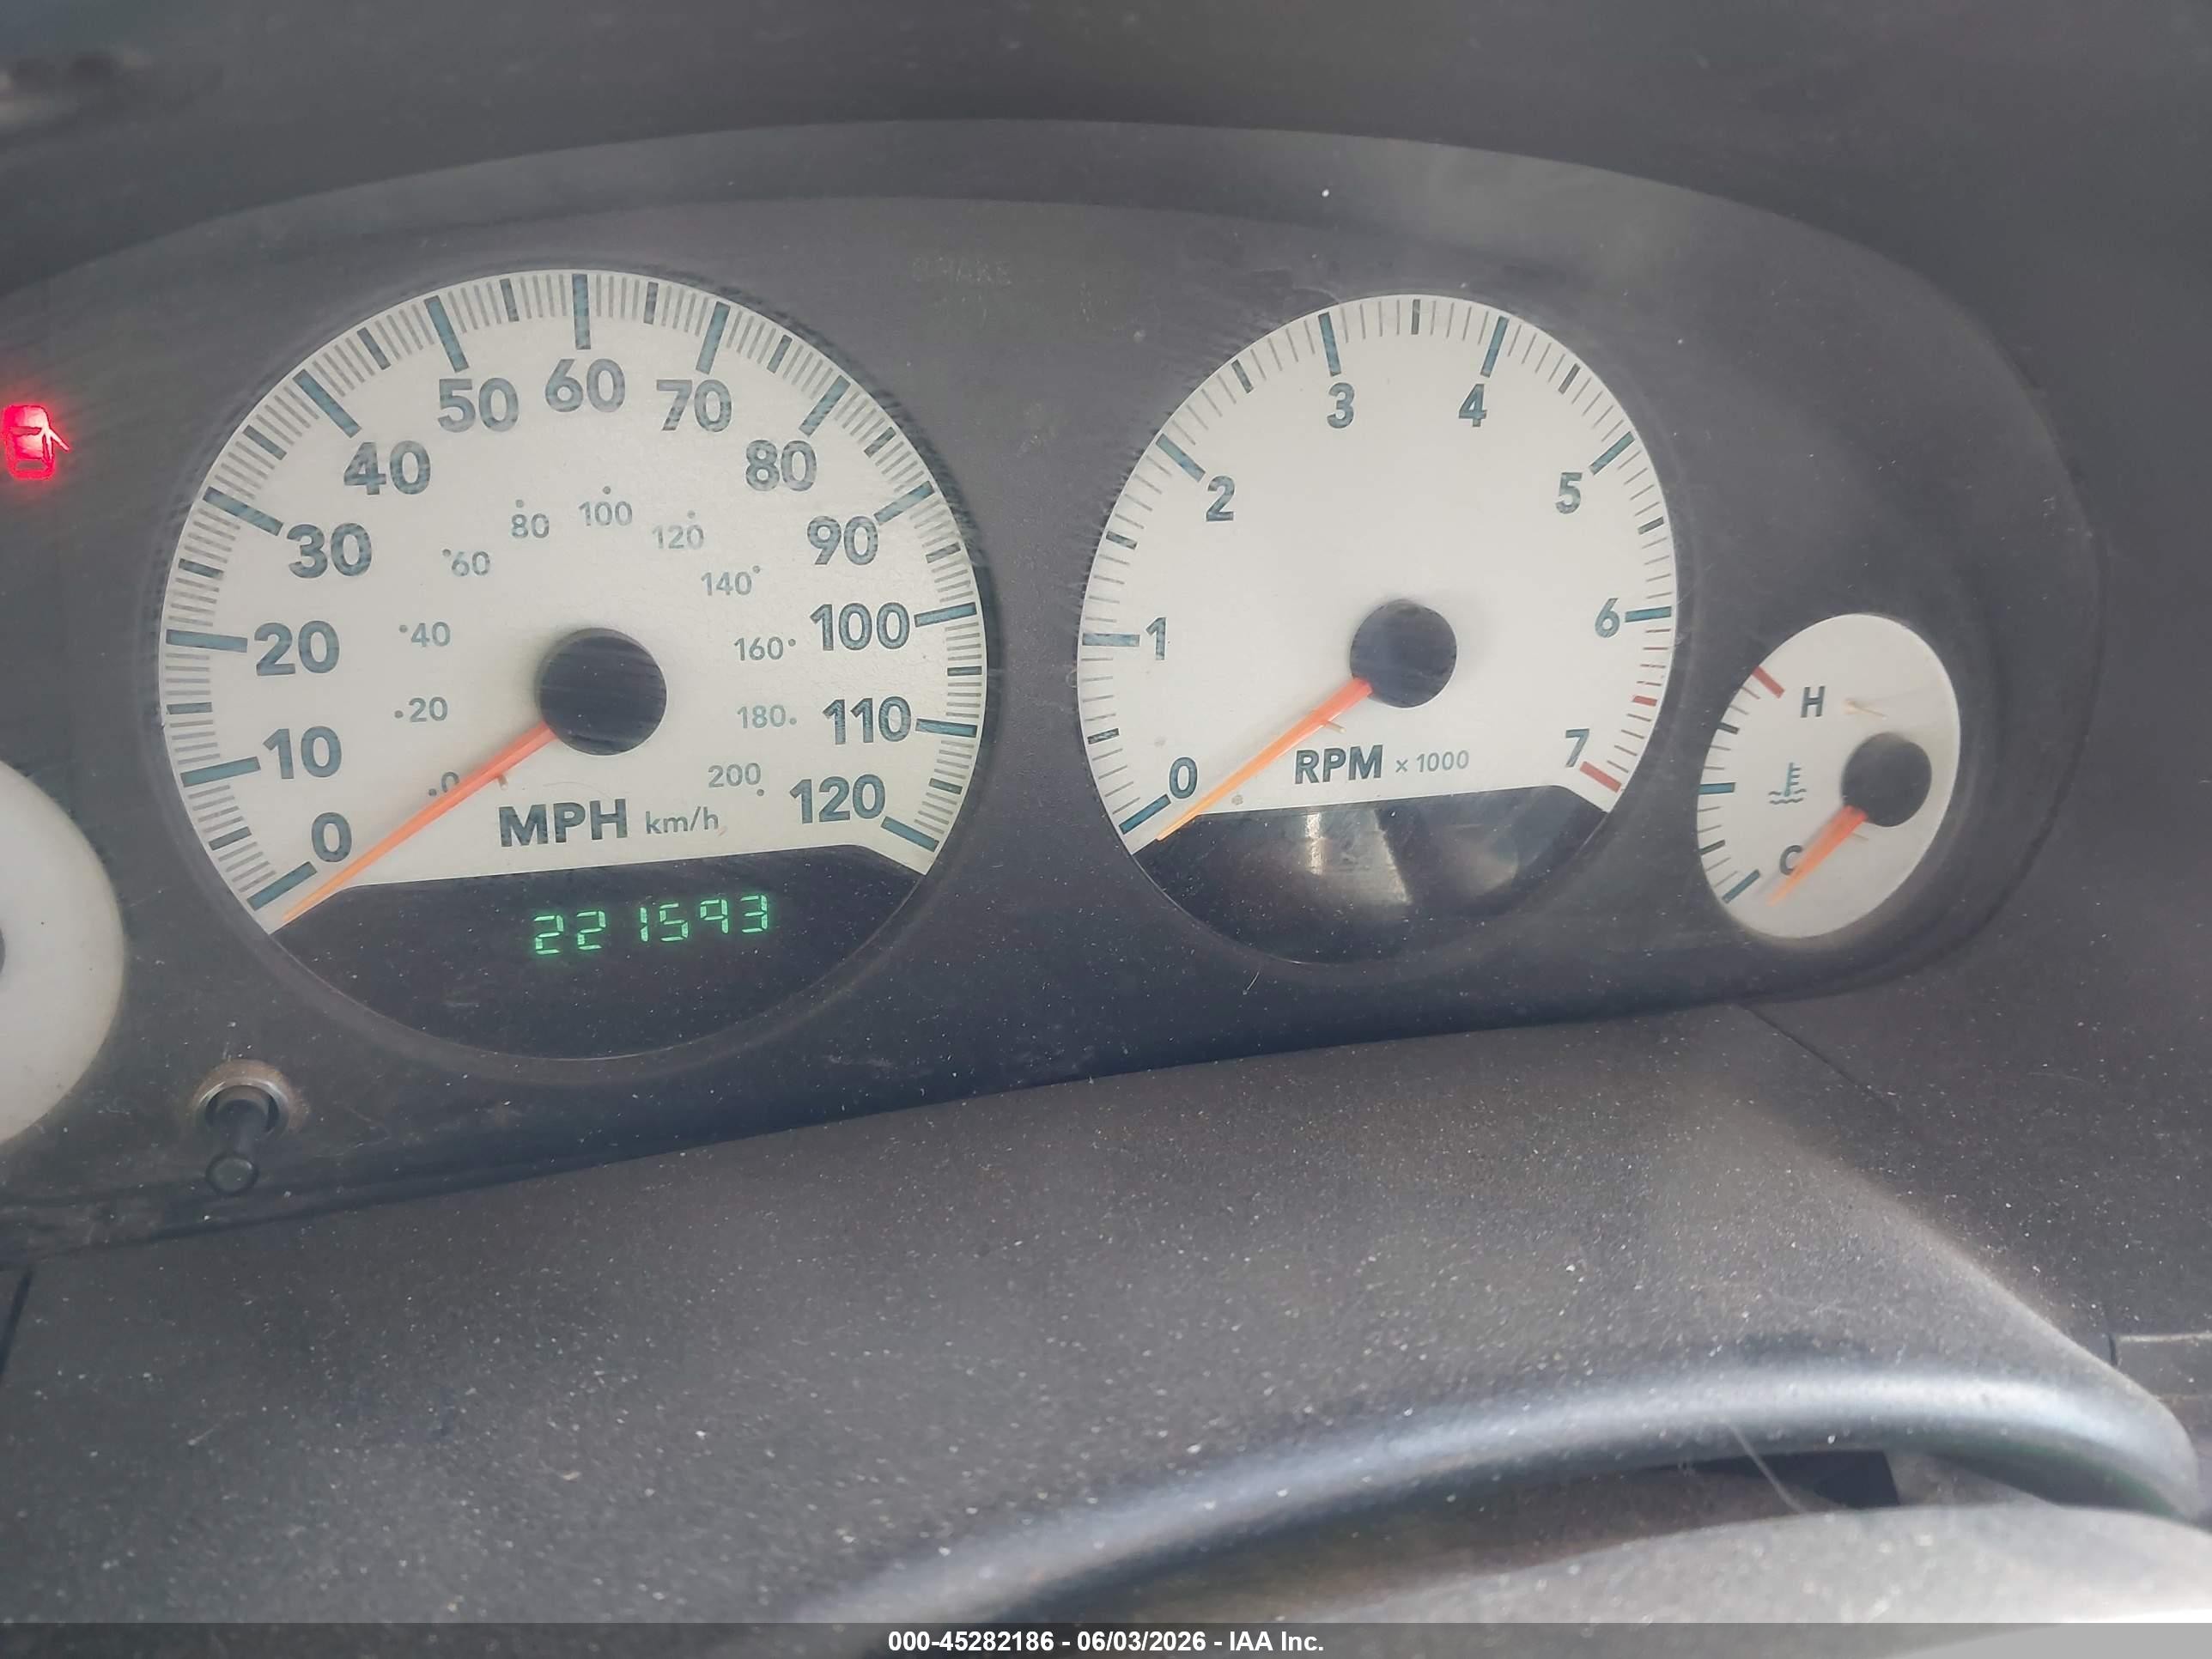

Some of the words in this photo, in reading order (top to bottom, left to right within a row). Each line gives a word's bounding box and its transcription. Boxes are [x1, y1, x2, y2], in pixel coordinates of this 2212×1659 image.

[438, 378, 519, 433] 50
[545, 359, 625, 412] 60
[656, 380, 732, 432] 70
[1327, 382, 1354, 428] 3
[1459, 384, 1487, 427] 4
[343, 441, 430, 495] 40
[746, 440, 817, 491] 80
[579, 501, 632, 526] 100
[1206, 476, 1235, 521] 2
[1556, 472, 1583, 514] 5
[512, 514, 550, 538] 80
[653, 525, 704, 550] 120
[807, 516, 878, 565] 90
[287, 523, 372, 578] 30
[452, 551, 490, 576] 60
[701, 572, 751, 596] 140
[410, 622, 450, 647] 40
[810, 602, 909, 651] 100
[1146, 617, 1166, 660] 1
[1595, 598, 1620, 638] 6
[254, 621, 339, 676] 20
[734, 636, 783, 660] 160
[409, 697, 447, 722] 20
[737, 705, 786, 728] 180
[823, 696, 911, 744] 110
[1801, 686, 1826, 718] H
[263, 726, 342, 779] 10
[1295, 744, 1382, 784] RPM
[1417, 750, 1468, 772] 1000
[1565, 728, 1589, 768] 7
[708, 763, 761, 787] 200
[1169, 757, 1198, 799] 0
[789, 775, 885, 823] 120
[312, 812, 352, 862] 0
[499, 799, 628, 847] MPH
[646, 806, 719, 834] km/h
[1779, 845, 1802, 875] C
[535, 895, 768, 955] 221593
